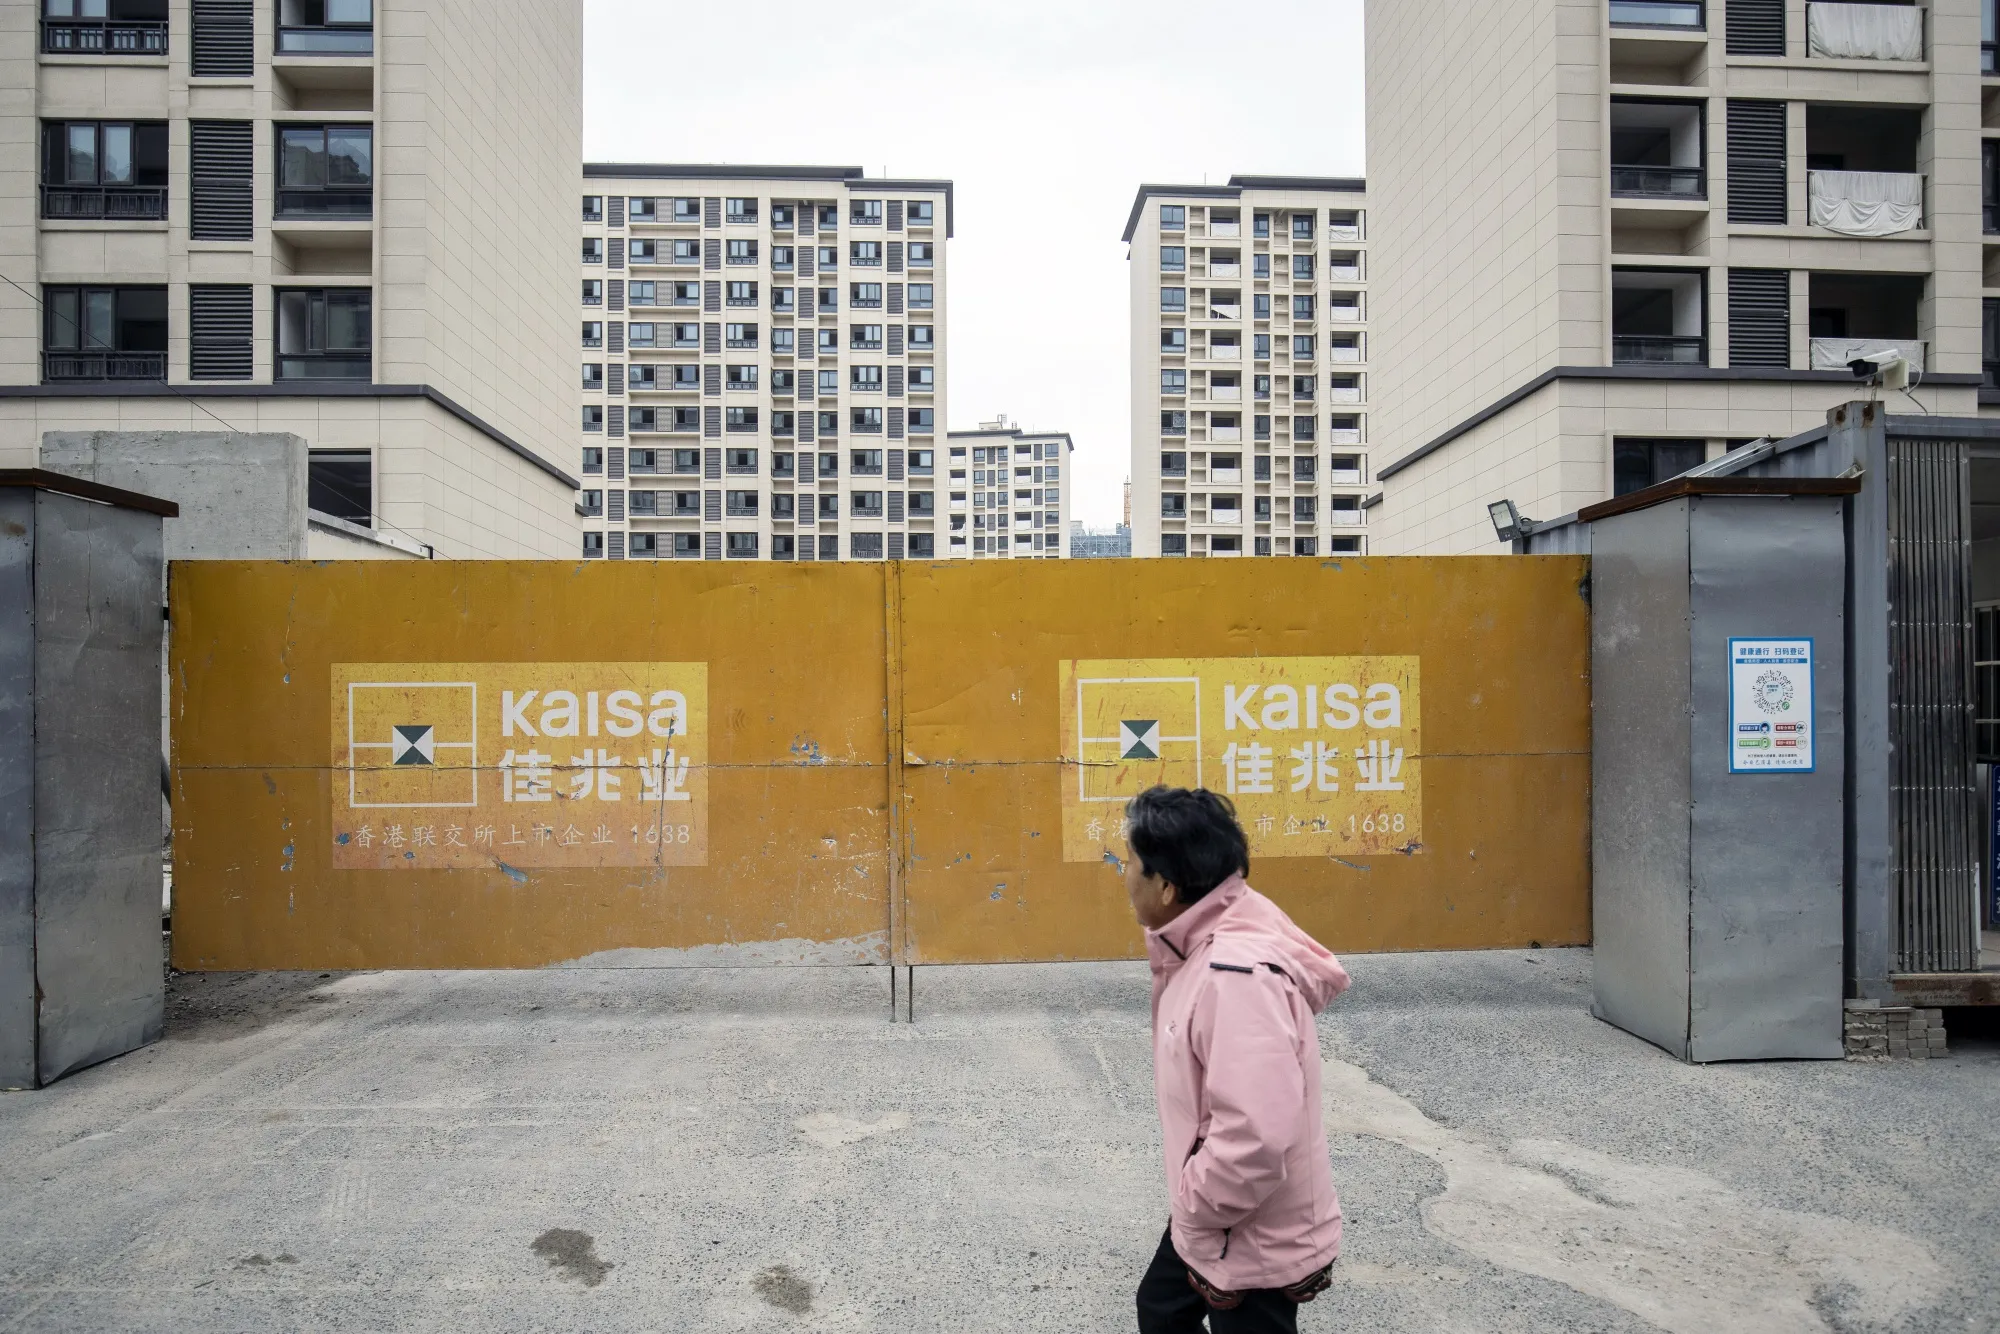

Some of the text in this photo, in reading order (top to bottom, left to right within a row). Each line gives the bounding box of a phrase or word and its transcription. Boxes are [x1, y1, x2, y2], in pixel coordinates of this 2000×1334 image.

[502, 689, 687, 737] Kaisa
[1223, 682, 1401, 731] Kaisa
[498, 748, 690, 803] 佳兆业
[1221, 739, 1404, 794] 佳兆业
[352, 823, 691, 849] 香港联交所上市企业 1638
[1347, 813, 1406, 834] 1638
